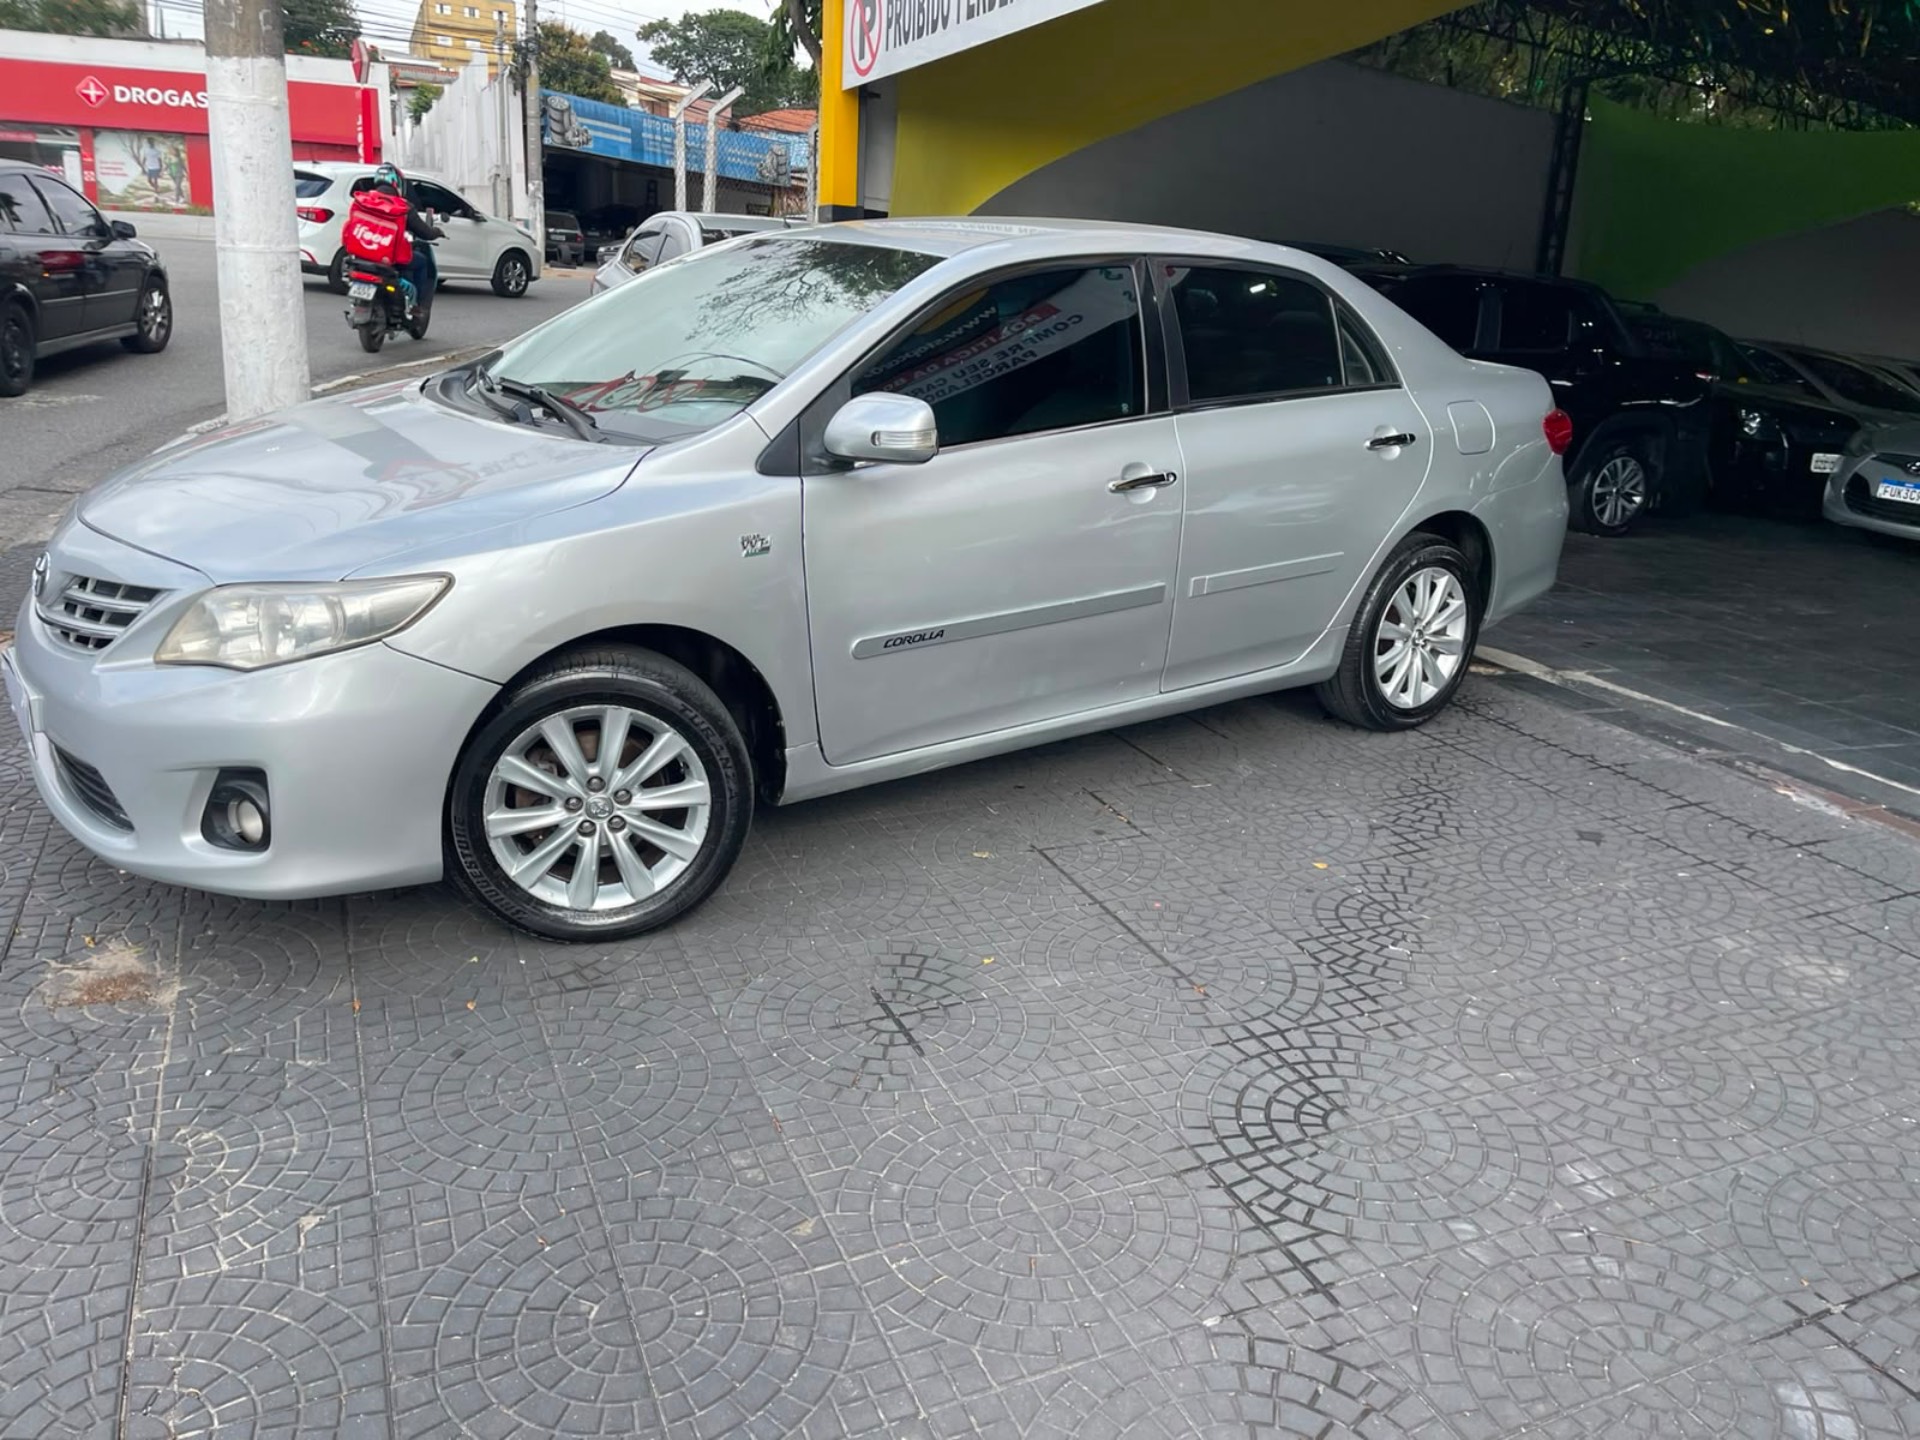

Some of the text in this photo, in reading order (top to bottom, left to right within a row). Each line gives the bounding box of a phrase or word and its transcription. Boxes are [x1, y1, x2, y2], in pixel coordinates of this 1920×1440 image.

[885, 0, 950, 51] PROIBIDO
[114, 85, 209, 108] DROGAS
[883, 629, 945, 649] COROLLA
